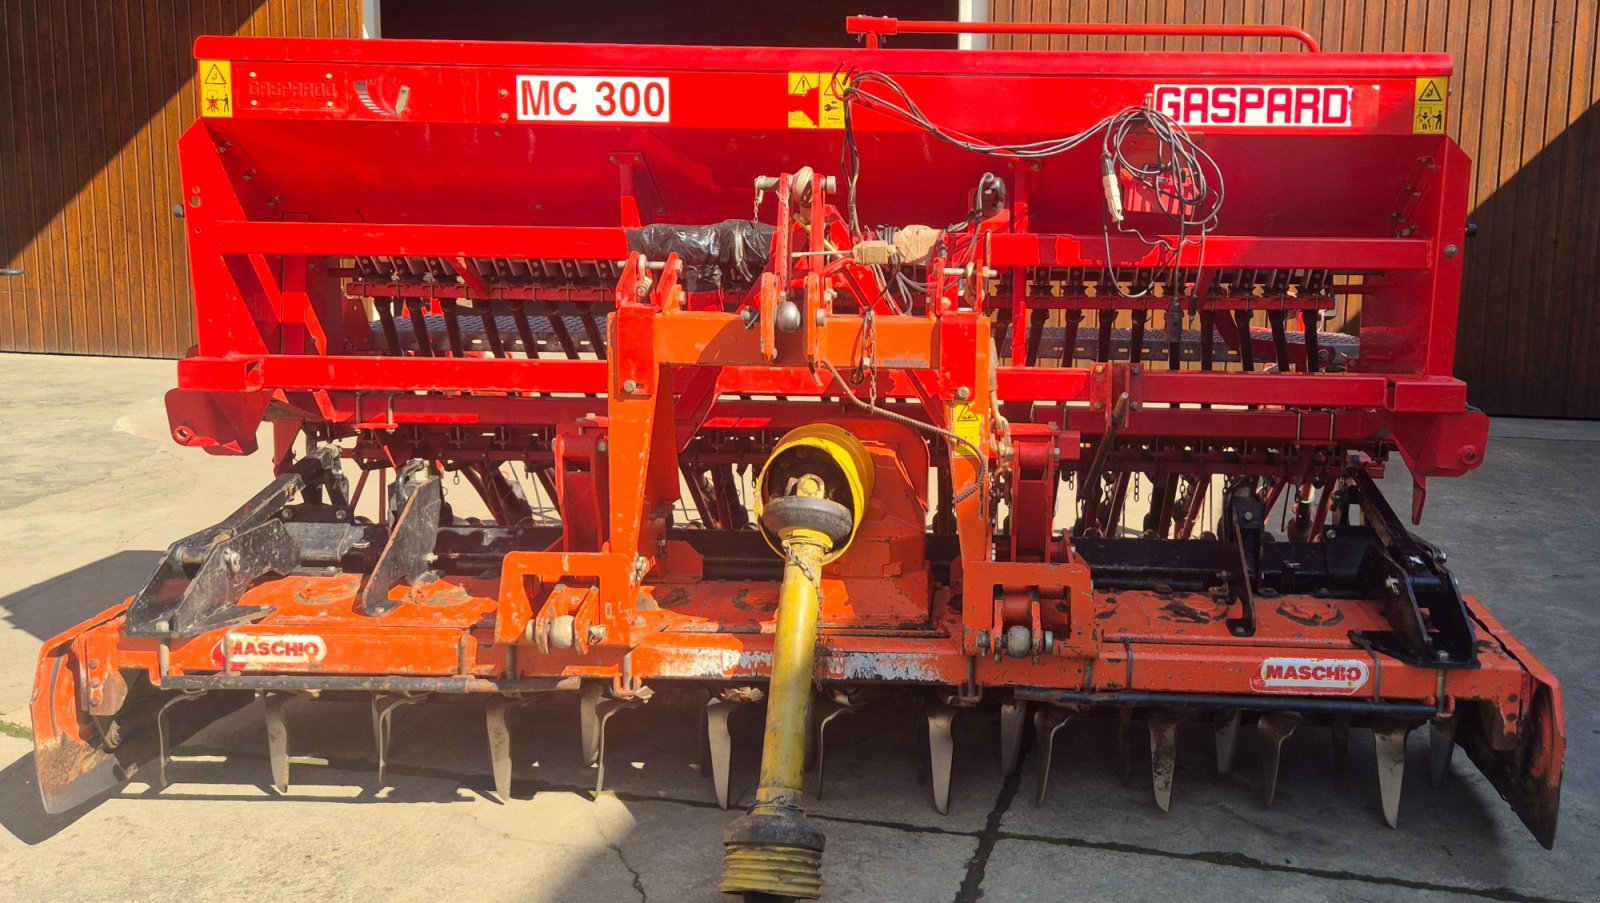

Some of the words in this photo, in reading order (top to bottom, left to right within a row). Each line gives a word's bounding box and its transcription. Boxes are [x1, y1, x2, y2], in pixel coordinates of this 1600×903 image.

[521, 80, 577, 116] MC
[595, 81, 664, 117] 300
[231, 640, 319, 657] MASCHIO
[1266, 664, 1362, 682] MASCHIO
